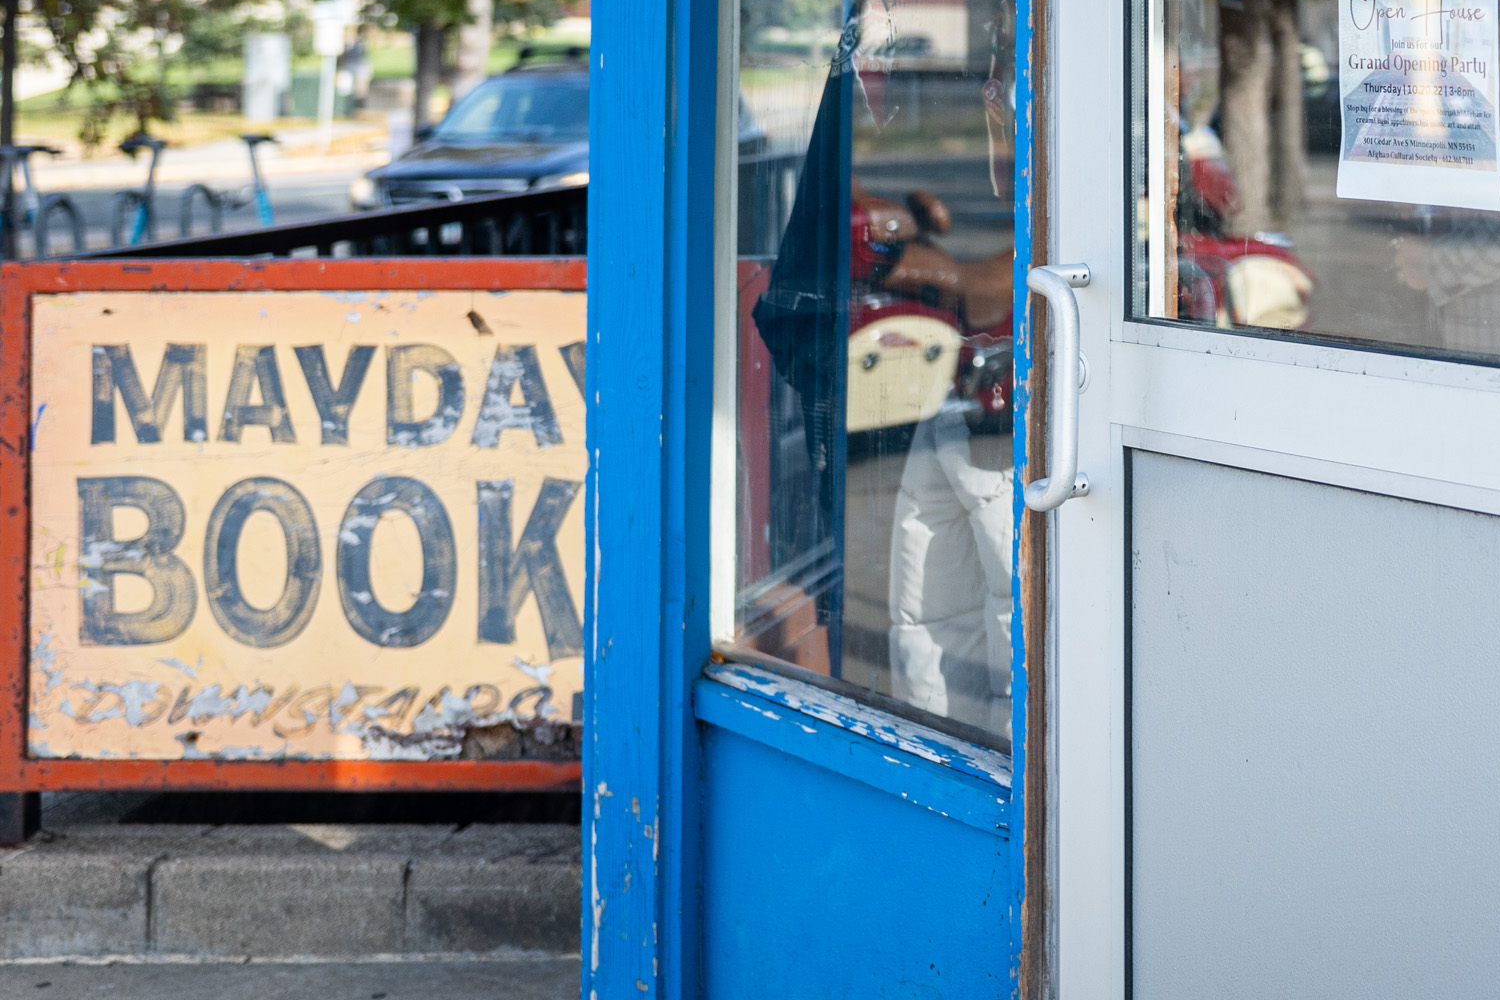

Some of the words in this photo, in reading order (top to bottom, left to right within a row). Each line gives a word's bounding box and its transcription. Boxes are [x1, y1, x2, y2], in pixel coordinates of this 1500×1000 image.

[1391, 39, 1406, 51] Join
[1407, 41, 1415, 50] us
[1348, 53, 1390, 70] Grand
[1393, 54, 1448, 77] Opening
[1451, 56, 1487, 78] Party
[1363, 82, 1402, 96] Thursday
[1407, 84, 1443, 96] 10.20.22
[1449, 86, 1475, 98] 3-8pm
[1363, 137, 1373, 145] 301
[1374, 137, 1391, 147] Cedar
[1393, 138, 1405, 147] Ave
[1448, 141, 1458, 150] MN
[1367, 149, 1389, 160] Afghan
[1390, 151, 1414, 161] Cultural
[1415, 153, 1437, 164] Society
[76, 474, 586, 661] BOOK
